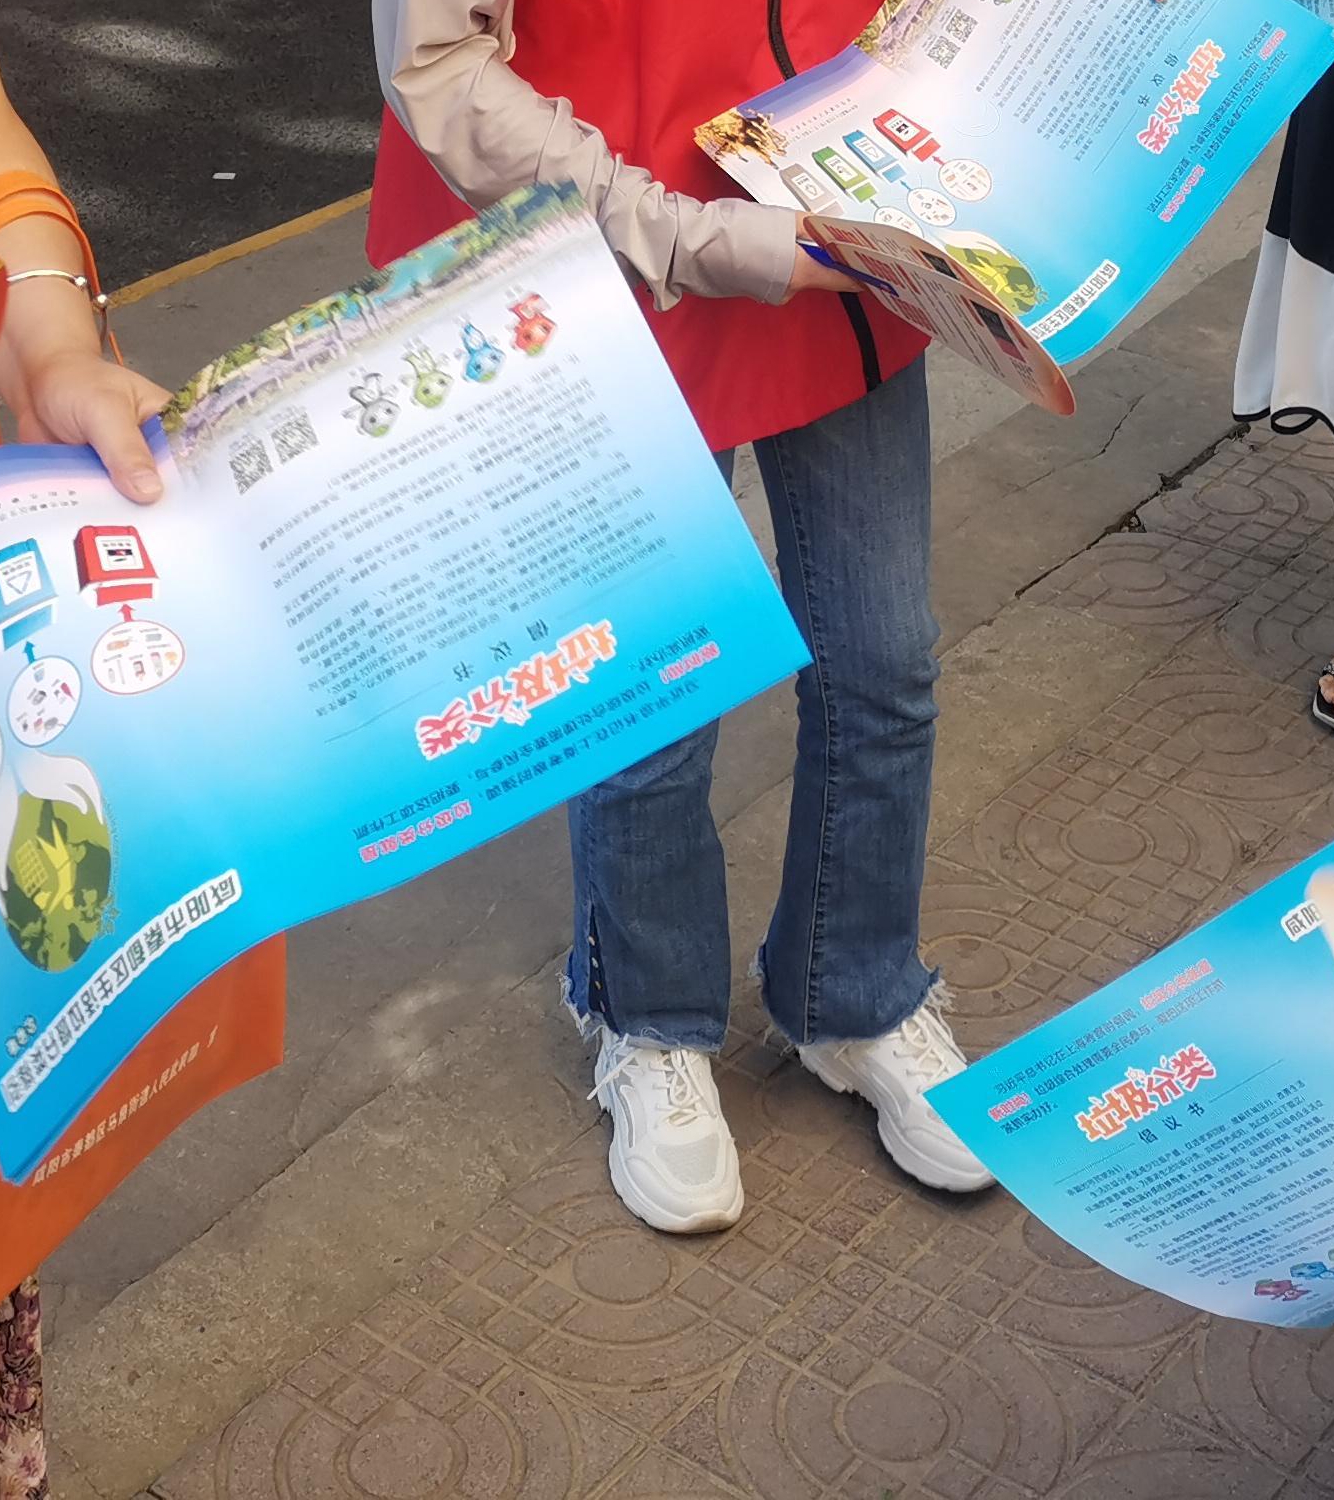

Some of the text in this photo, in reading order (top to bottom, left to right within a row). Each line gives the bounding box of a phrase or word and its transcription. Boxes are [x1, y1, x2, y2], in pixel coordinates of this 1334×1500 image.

[1137, 40, 1224, 155] 垃圾分类
[411, 618, 619, 758] 垃圾分类
[451, 618, 550, 681] 倡议书
[1073, 1040, 1217, 1146] 垃圾分类
[1137, 1099, 1206, 1147] 倡议书
